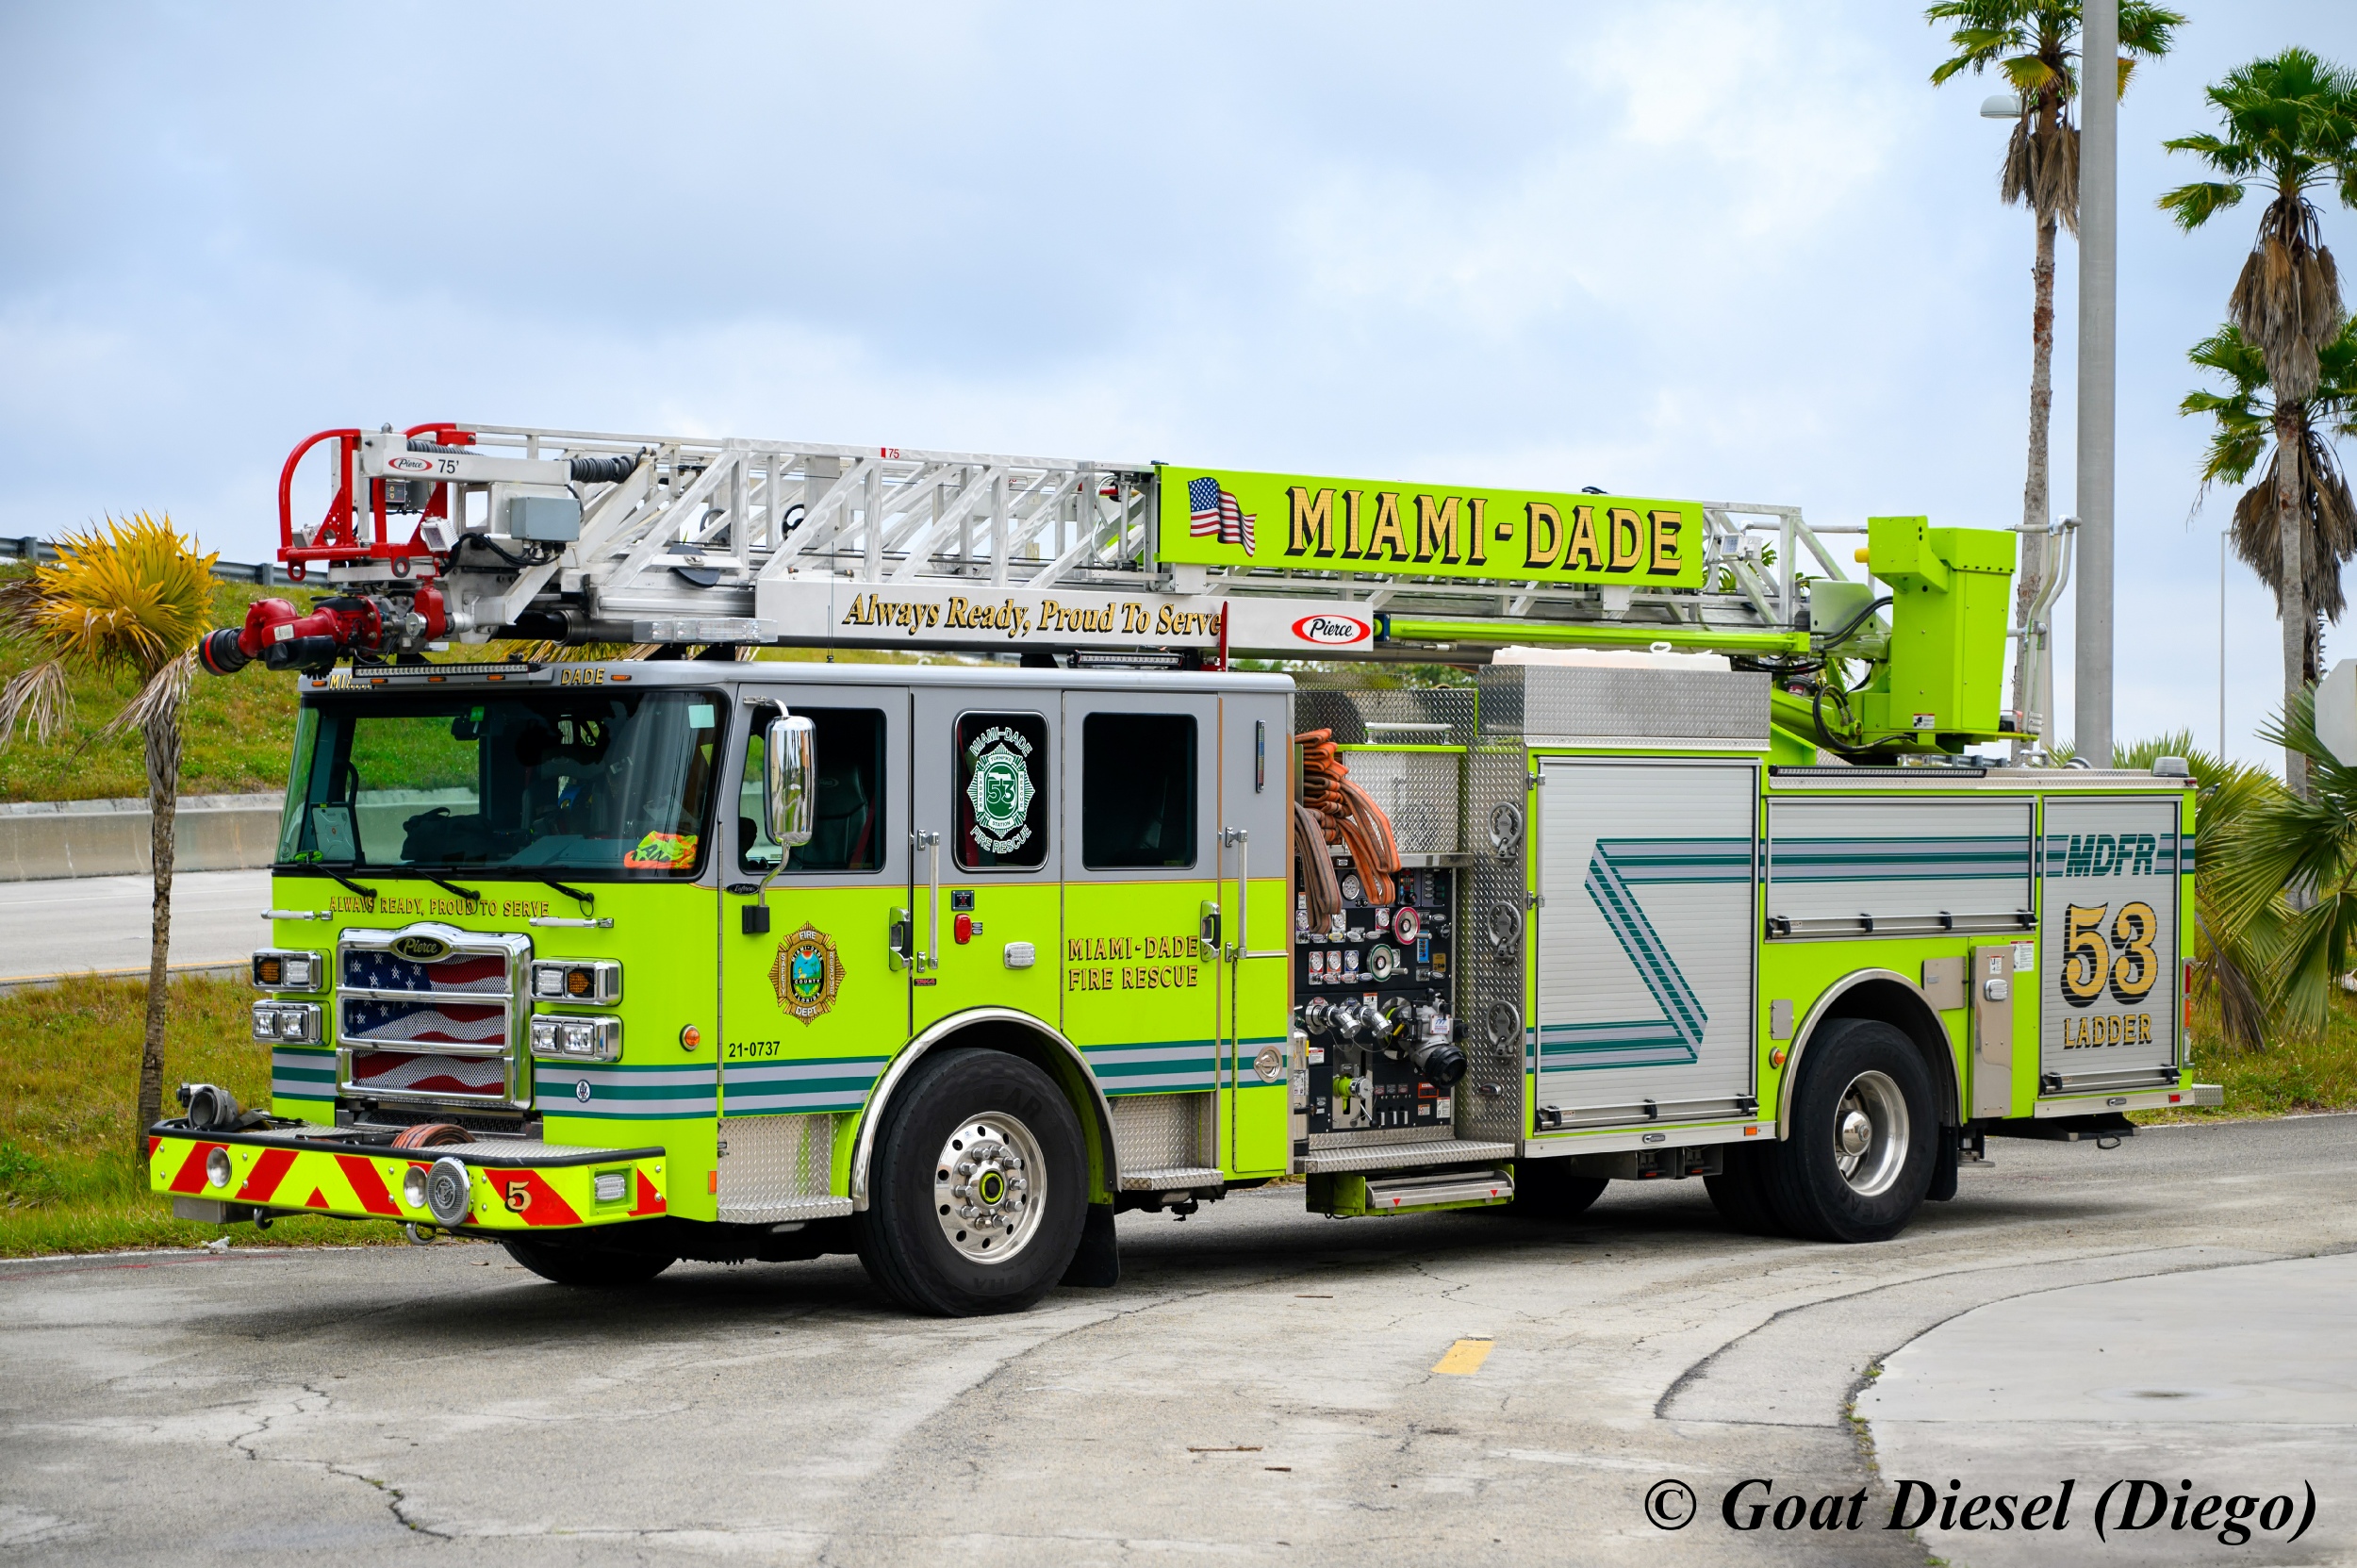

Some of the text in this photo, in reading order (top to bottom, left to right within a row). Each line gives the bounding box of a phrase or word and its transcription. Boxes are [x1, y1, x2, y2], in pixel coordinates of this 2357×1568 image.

[398, 458, 422, 469] Pierce
[888, 448, 900, 459] 75
[1283, 487, 1682, 576] MIAMI-DADE
[841, 592, 1222, 638] Always Ready, Proud To Serve
[1310, 618, 1353, 638] Pierce
[561, 668, 605, 685] DADE
[969, 726, 1033, 757] MIAMI-DADE
[986, 779, 1015, 804] 53
[969, 824, 1032, 854] FIRE RESCUE
[2066, 834, 2156, 877] MDFR
[330, 897, 550, 917] ALWAYS READY, PROUD TO SERVE
[403, 937, 438, 958] Pierce
[799, 931, 816, 940] FIRE
[1068, 935, 1199, 961] MIAMI-DADE
[2060, 900, 2159, 1008] 53
[1068, 965, 1198, 991] FIRE RESCUE
[794, 992, 820, 1003] FLORIDA
[795, 1005, 820, 1016] DEPT.
[2063, 1013, 2152, 1049] LADDER
[728, 1040, 781, 1058] 21-0737
[504, 1180, 533, 1213] 5
